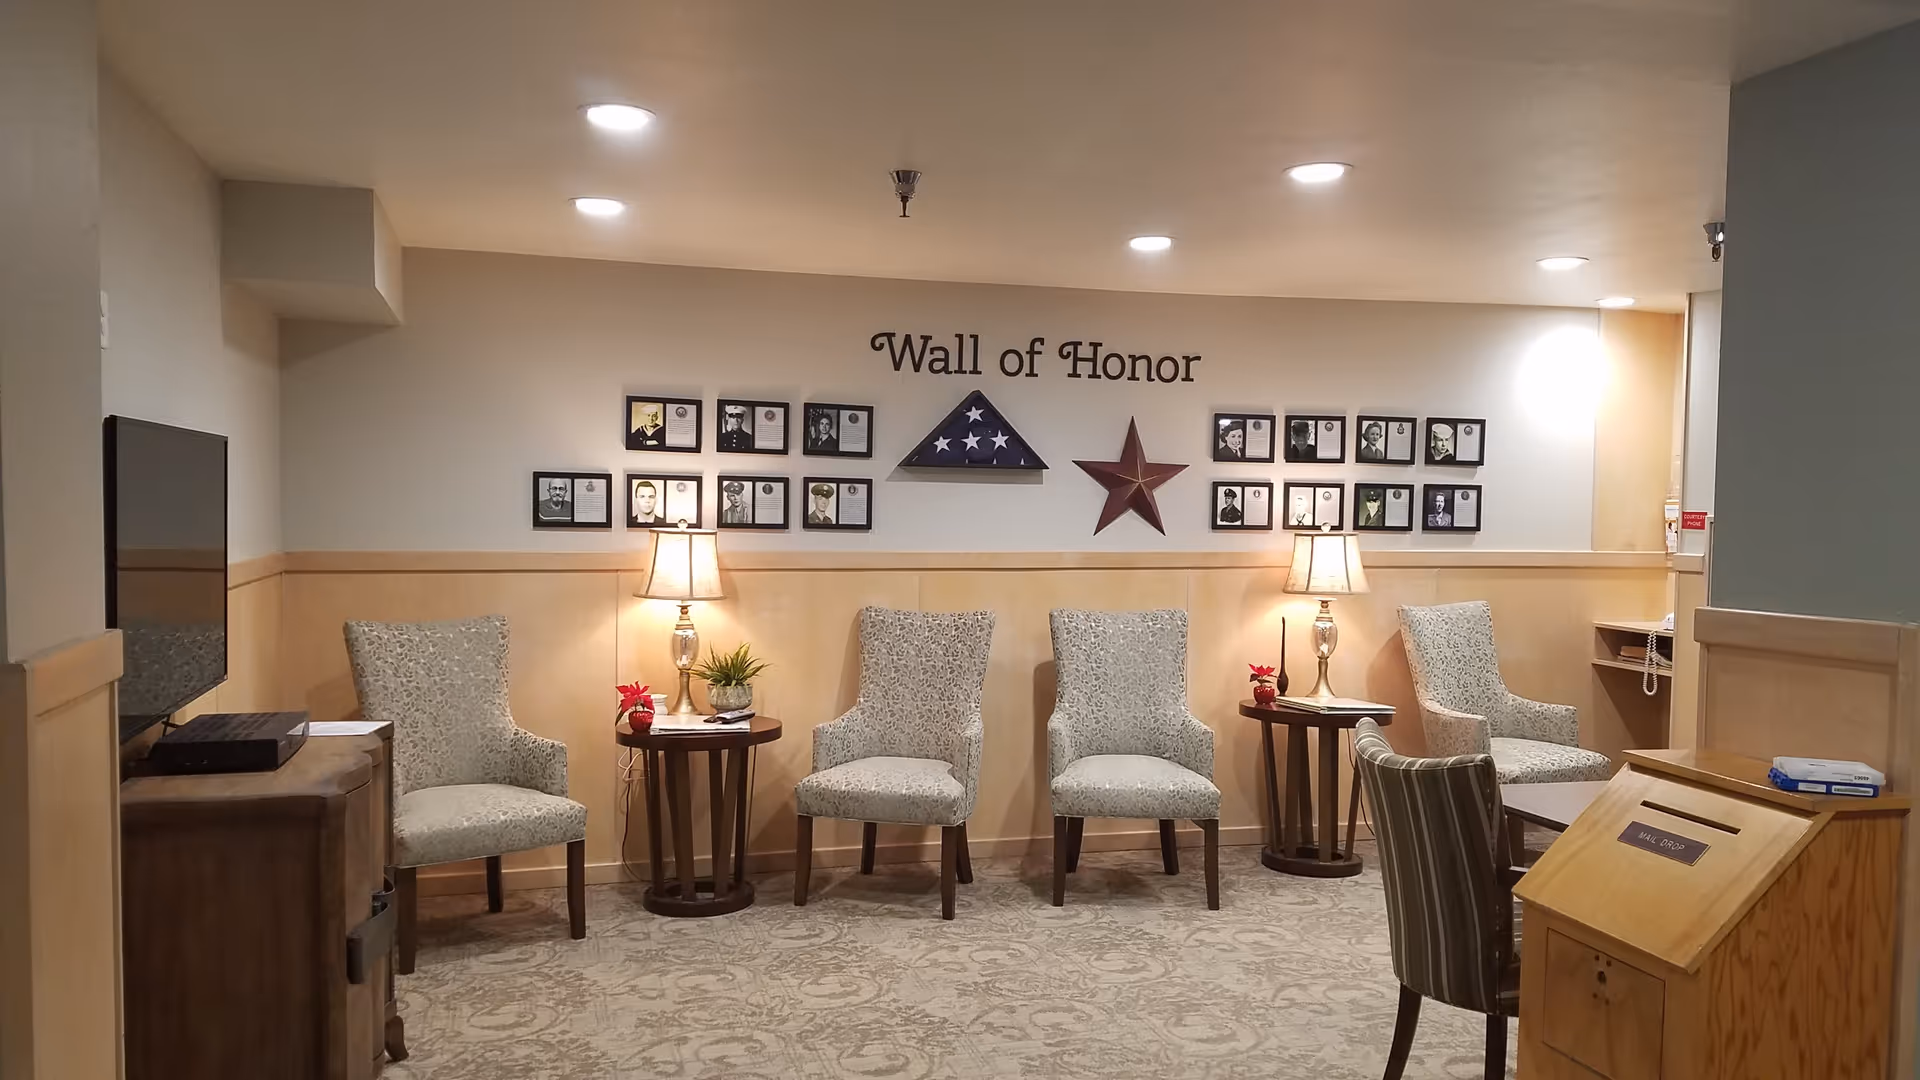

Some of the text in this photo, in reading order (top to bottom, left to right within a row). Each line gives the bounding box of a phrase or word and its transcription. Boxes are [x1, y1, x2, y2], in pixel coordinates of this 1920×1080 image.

[870, 332, 1202, 384] Wall of Honor
[1638, 831, 1685, 851] MAIL DROP
